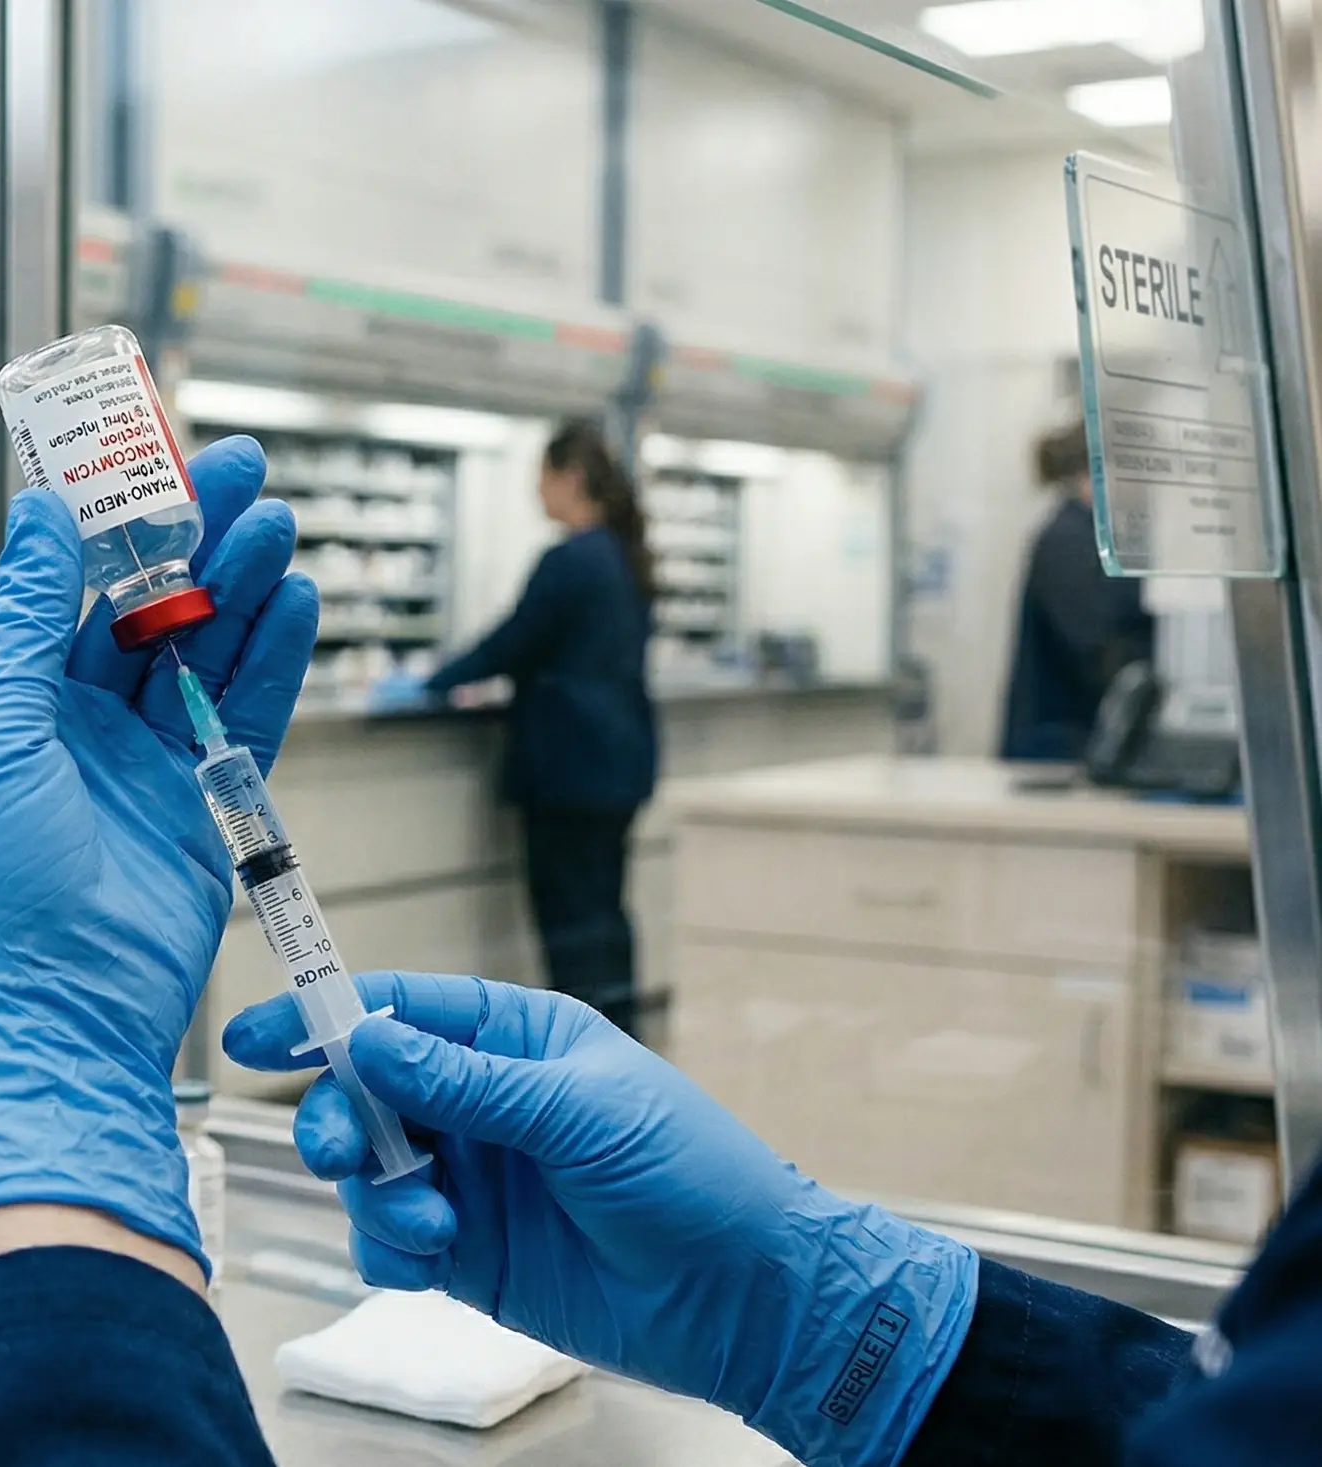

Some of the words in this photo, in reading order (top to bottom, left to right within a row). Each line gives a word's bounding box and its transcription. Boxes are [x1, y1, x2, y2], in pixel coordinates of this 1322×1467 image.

[1099, 244, 1205, 326] STERILE
[63, 440, 164, 486] VANCOMYCIN
[79, 503, 94, 522] IV
[255, 803, 267, 818] 2
[266, 830, 279, 844] 3
[291, 887, 303, 901] 6
[302, 914, 314, 929] 9
[314, 938, 332, 954] 10
[828, 1340, 886, 1418] STERILE
